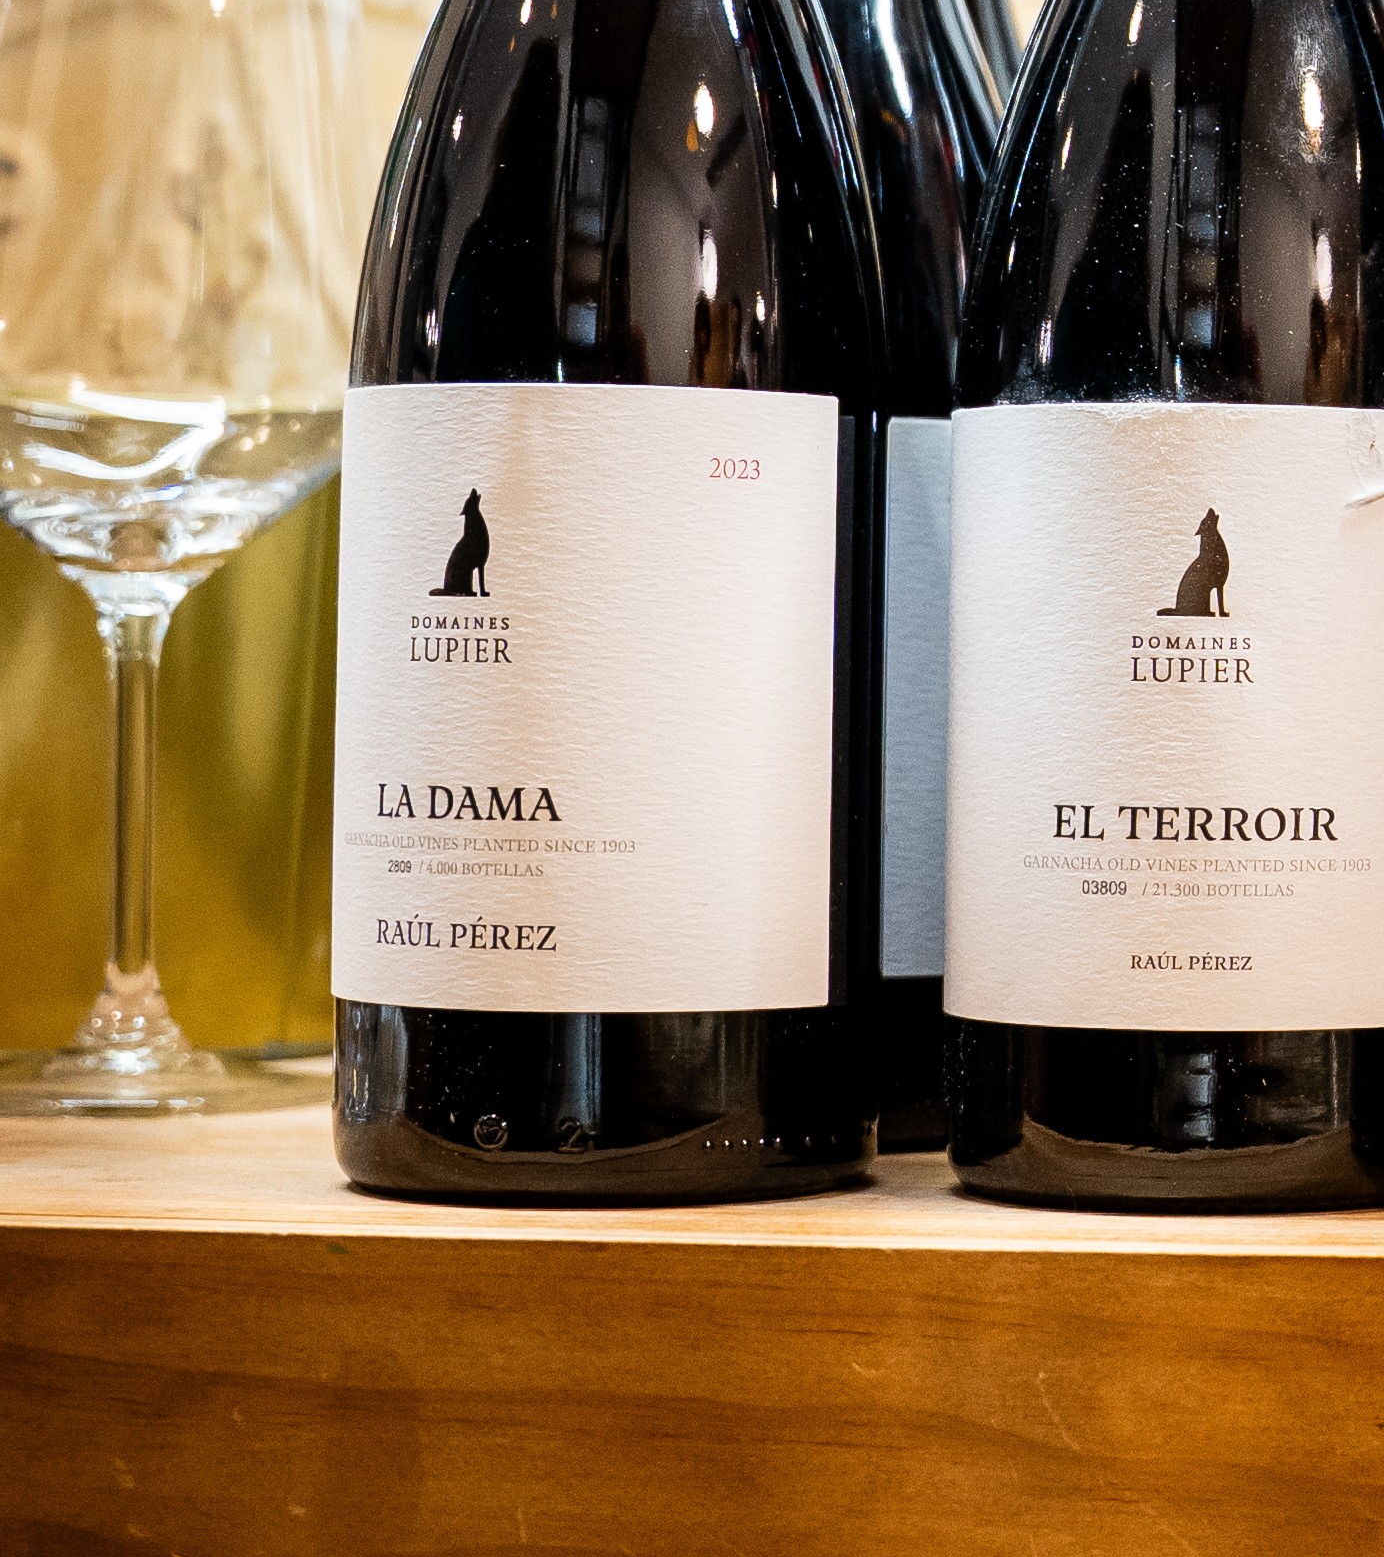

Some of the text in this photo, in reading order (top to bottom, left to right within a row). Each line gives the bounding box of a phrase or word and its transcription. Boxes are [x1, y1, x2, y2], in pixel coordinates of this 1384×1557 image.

[708, 457, 762, 481] 2023
[410, 615, 511, 631] DOMAINES
[409, 636, 513, 665] LUPIER
[1131, 635, 1252, 651] DOMAINES
[1130, 656, 1255, 684] LUPIER
[377, 782, 564, 823] LA DAMA
[1052, 804, 1340, 843] EL TERROIR
[392, 835, 416, 849] OLD
[418, 836, 460, 851] VINES
[462, 837, 540, 853] PLANTED
[543, 838, 596, 854] SINCE
[601, 839, 637, 854] 1903
[387, 859, 413, 874] 2809
[461, 862, 545, 878] BOTELLAS
[1023, 854, 1372, 873] GARNACHA OLD VINES PLANTED SINCE 1903
[1081, 879, 1128, 896] 03809
[1205, 883, 1295, 898] BOTELLAS
[376, 913, 558, 953] RAÚL PÉREZ
[1129, 950, 1254, 972] RAÚL PÉREZ
